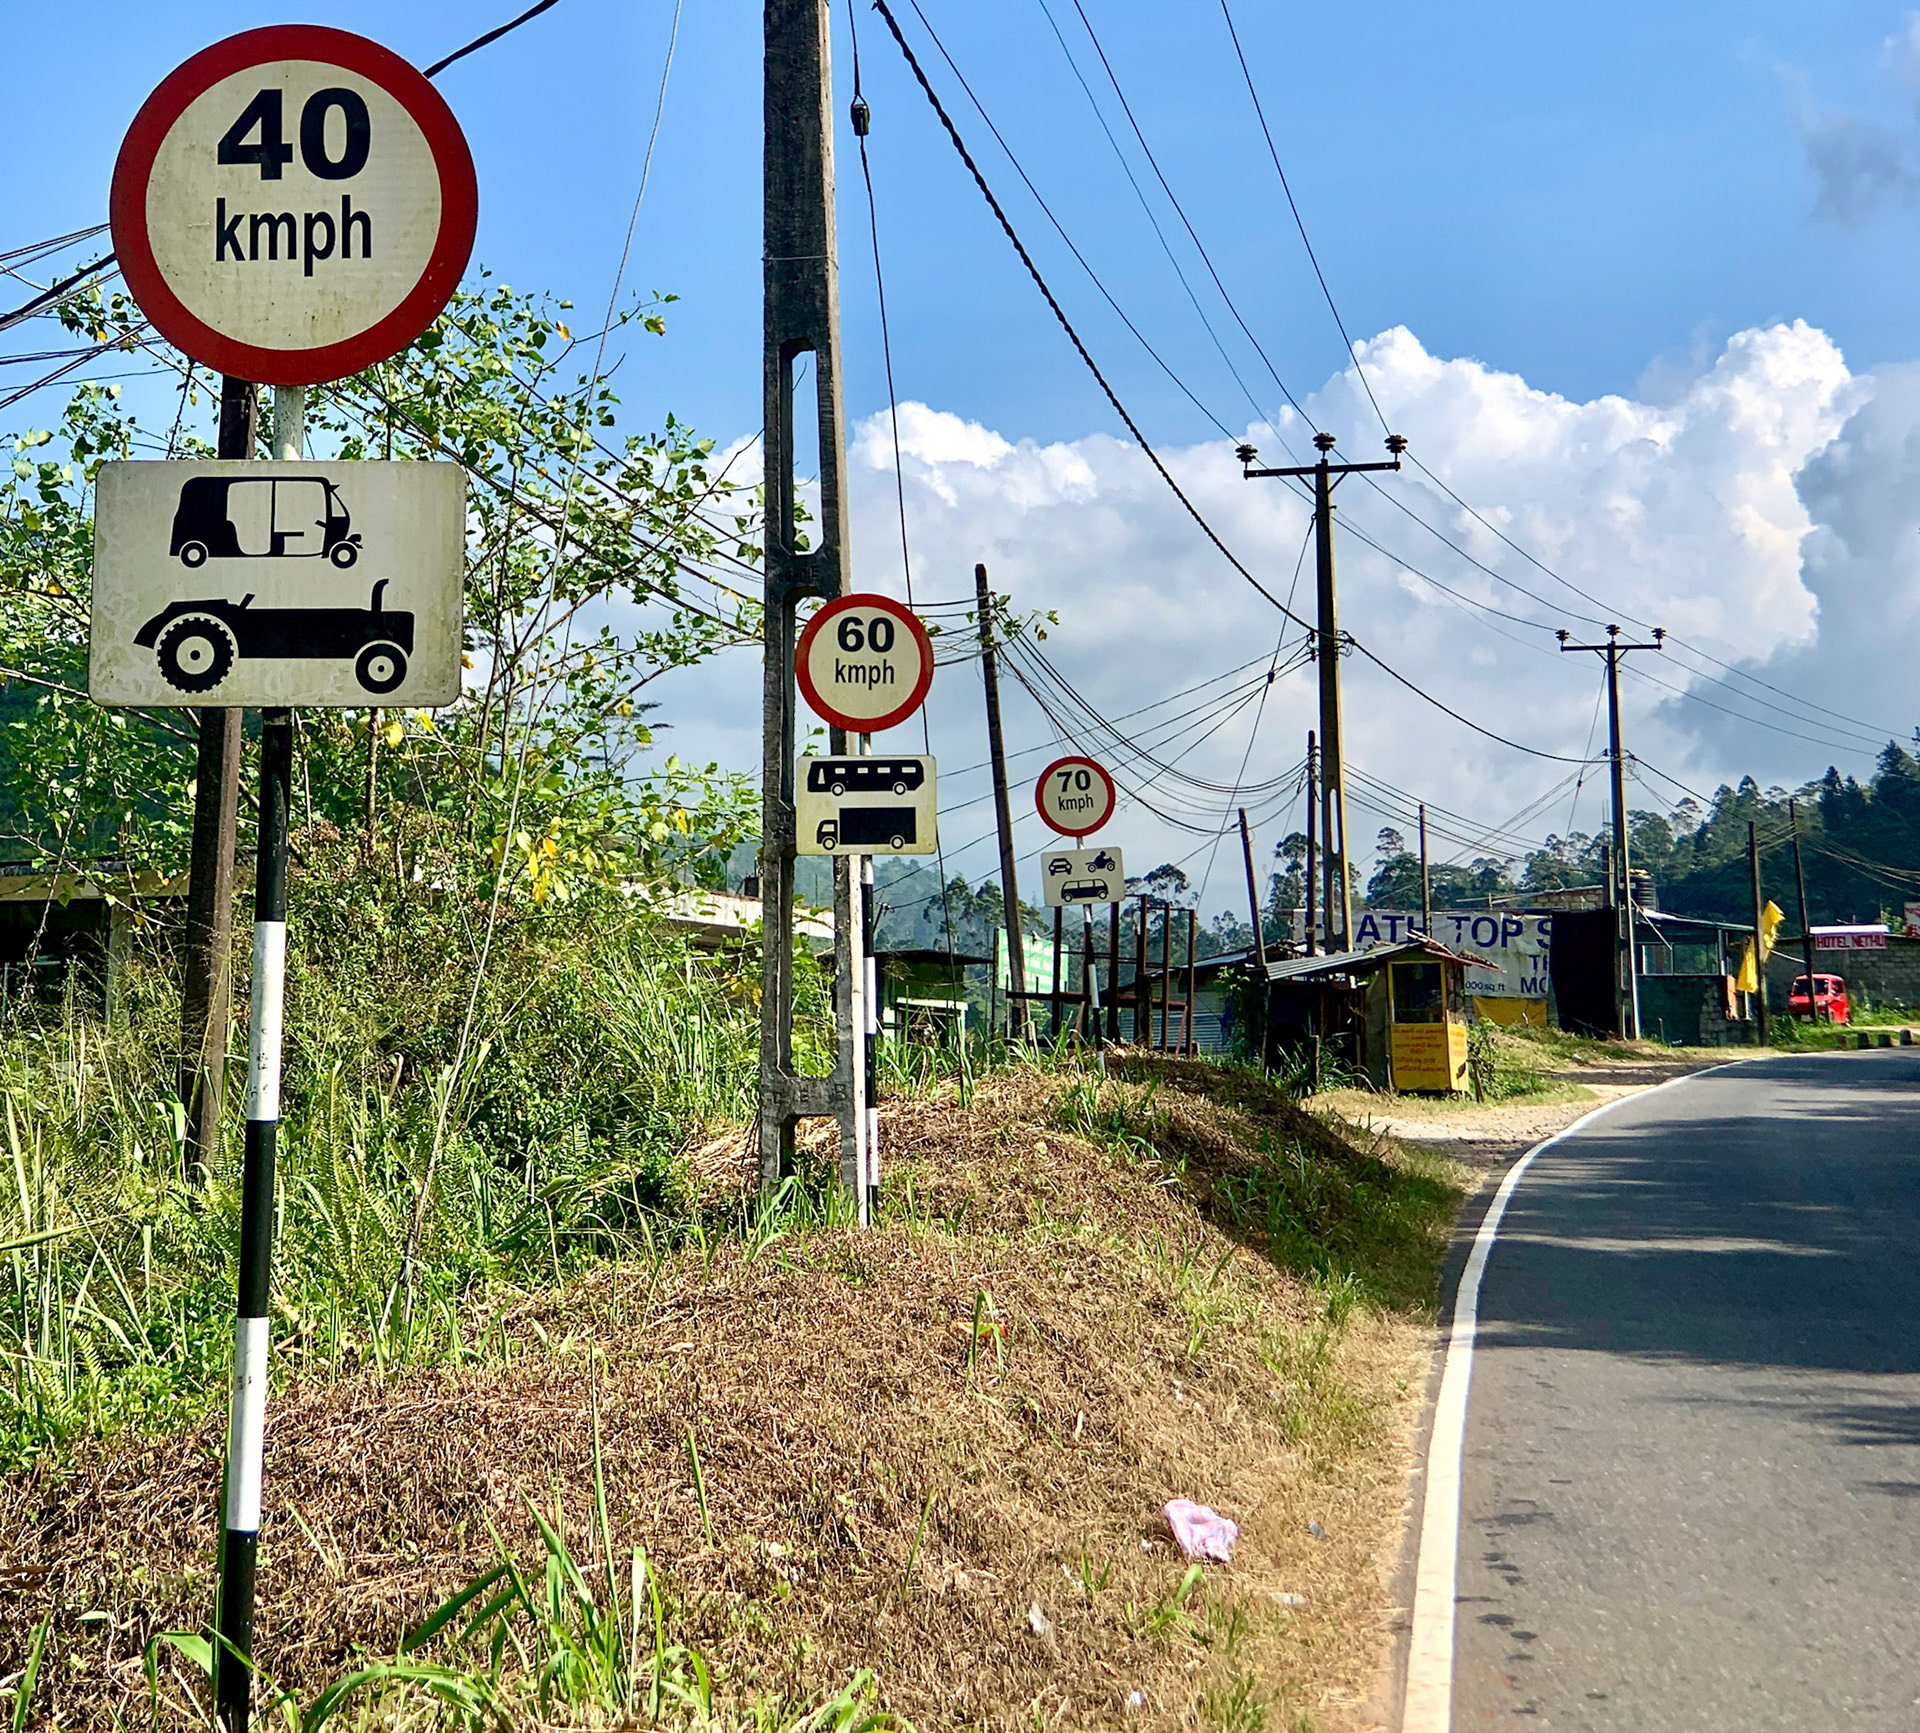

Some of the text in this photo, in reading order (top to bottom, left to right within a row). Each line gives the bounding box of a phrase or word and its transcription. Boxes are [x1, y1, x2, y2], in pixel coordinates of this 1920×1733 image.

[217, 87, 371, 181] 40
[215, 194, 372, 277] kmph
[837, 616, 895, 653] 60
[834, 657, 895, 691] kmph
[1056, 769, 1091, 793] 70
[1057, 793, 1094, 813] kmph
[1446, 915, 1524, 948] TOP
[1816, 935, 1850, 948] HOTEL
